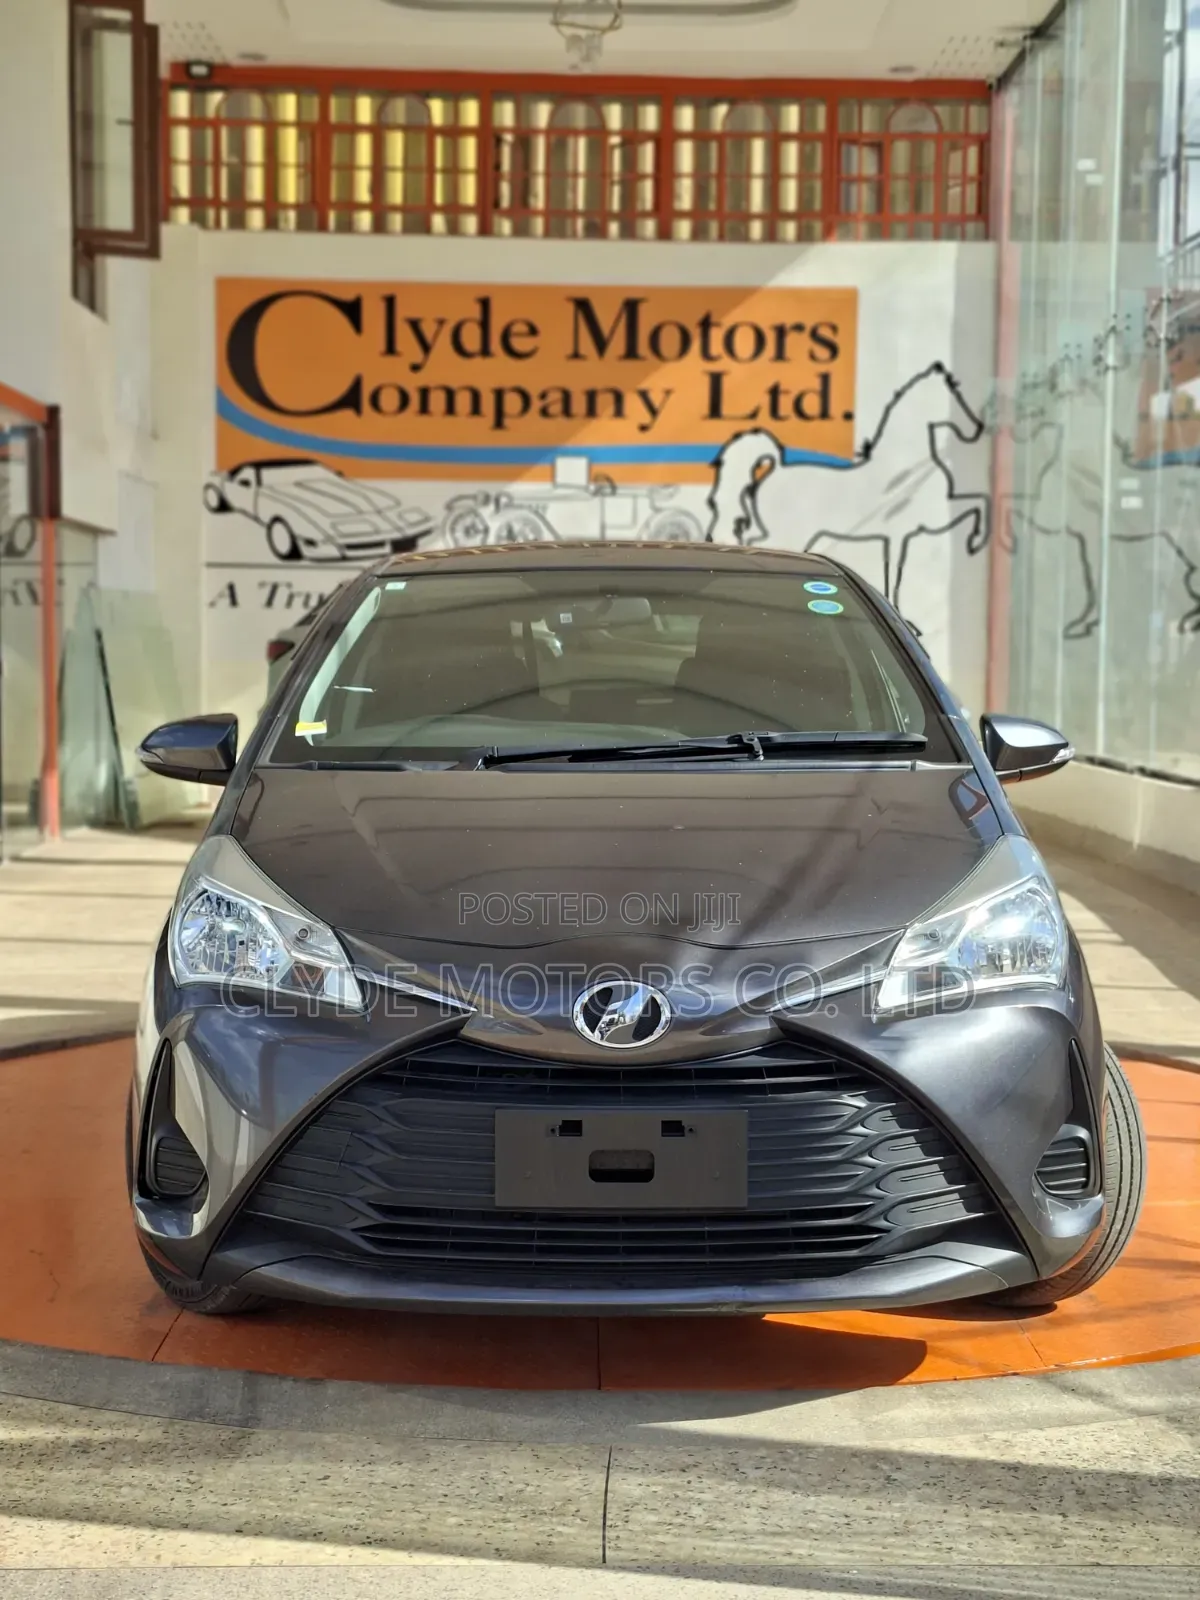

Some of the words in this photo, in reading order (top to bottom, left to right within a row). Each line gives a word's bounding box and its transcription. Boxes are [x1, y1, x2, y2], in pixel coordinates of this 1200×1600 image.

[226, 290, 540, 418] Clyde
[566, 297, 840, 363] Motors
[702, 371, 854, 421] Ltd.
[208, 581, 239, 608] A
